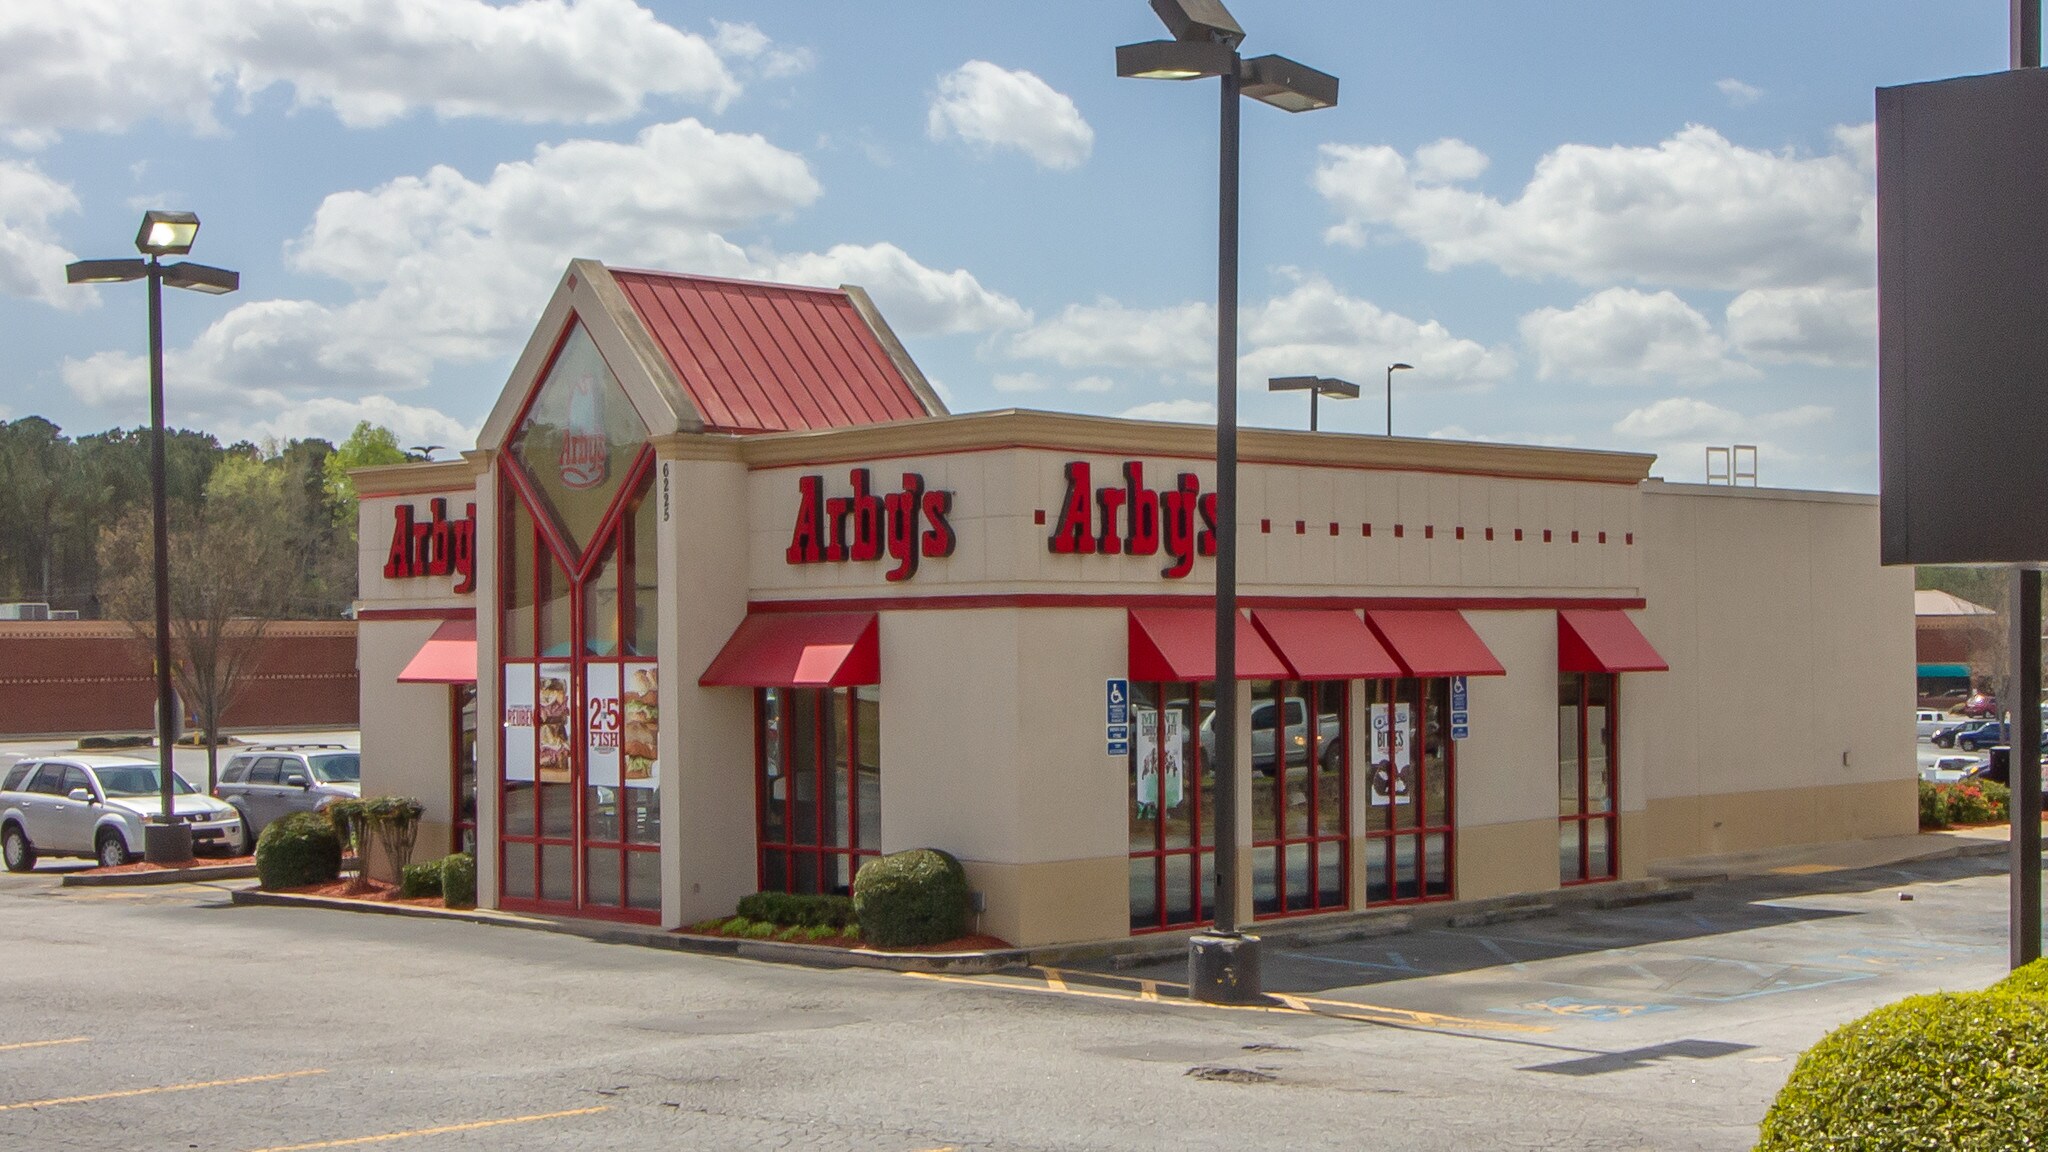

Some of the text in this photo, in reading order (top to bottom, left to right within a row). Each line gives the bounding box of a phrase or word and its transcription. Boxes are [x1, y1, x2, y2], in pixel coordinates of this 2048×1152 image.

[662, 462, 670, 522] 6225
[786, 468, 956, 582] Arby's
[590, 731, 619, 748] FISH
